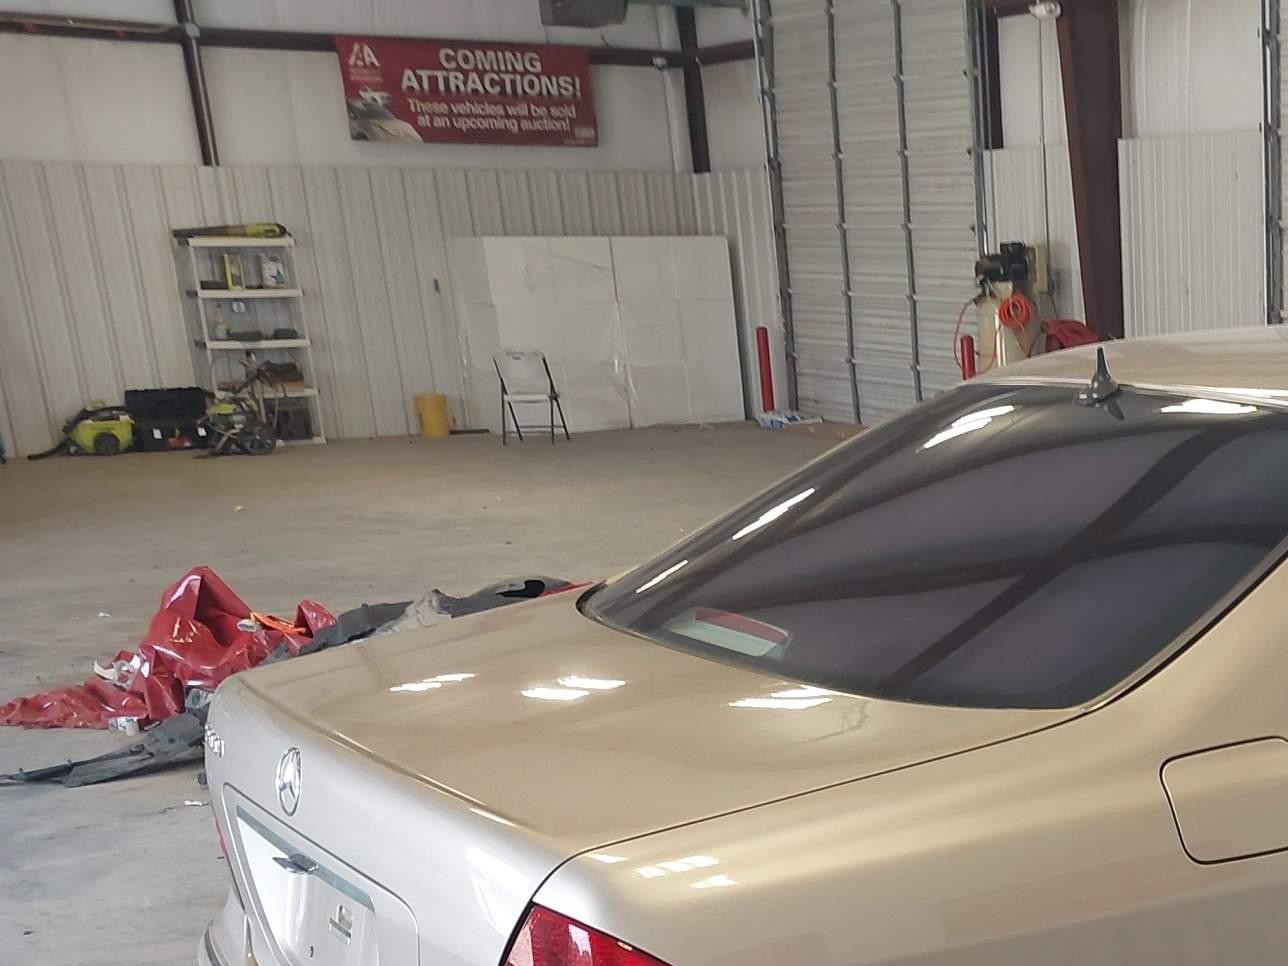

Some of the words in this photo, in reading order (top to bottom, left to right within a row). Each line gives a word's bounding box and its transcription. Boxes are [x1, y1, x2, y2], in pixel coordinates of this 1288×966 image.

[438, 48, 542, 73] COMING
[401, 68, 581, 99] ATTRACTIONS!
[407, 98, 449, 114] These
[450, 101, 505, 117] vehicles
[506, 104, 529, 118] will
[530, 103, 549, 118] be
[549, 104, 577, 119] sold
[417, 114, 432, 128] at
[433, 115, 451, 129] an
[452, 115, 519, 133] upcoming
[520, 117, 571, 132] auction!
